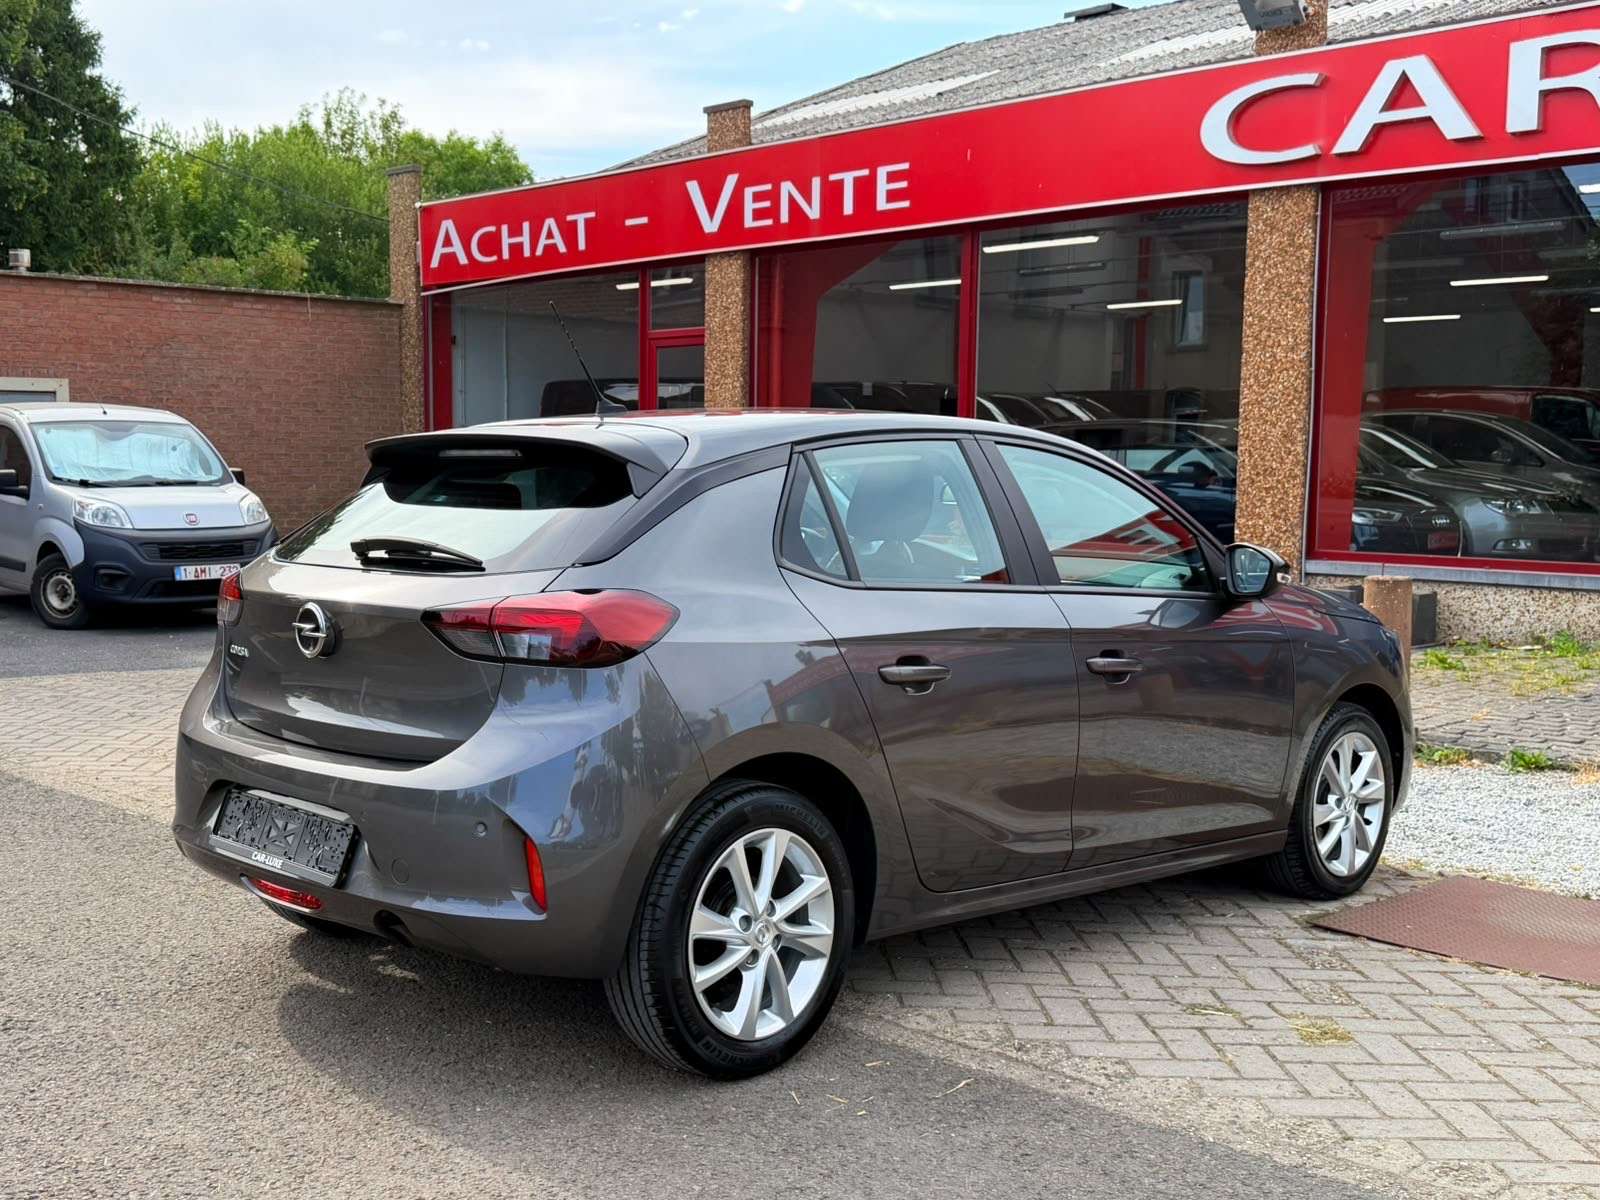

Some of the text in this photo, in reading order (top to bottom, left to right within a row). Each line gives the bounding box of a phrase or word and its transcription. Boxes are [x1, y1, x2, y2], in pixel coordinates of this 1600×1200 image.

[1200, 29, 1600, 164] CAR
[430, 162, 911, 268] ACHAT - VENTE
[251, 851, 283, 869] CAR-LUXE
